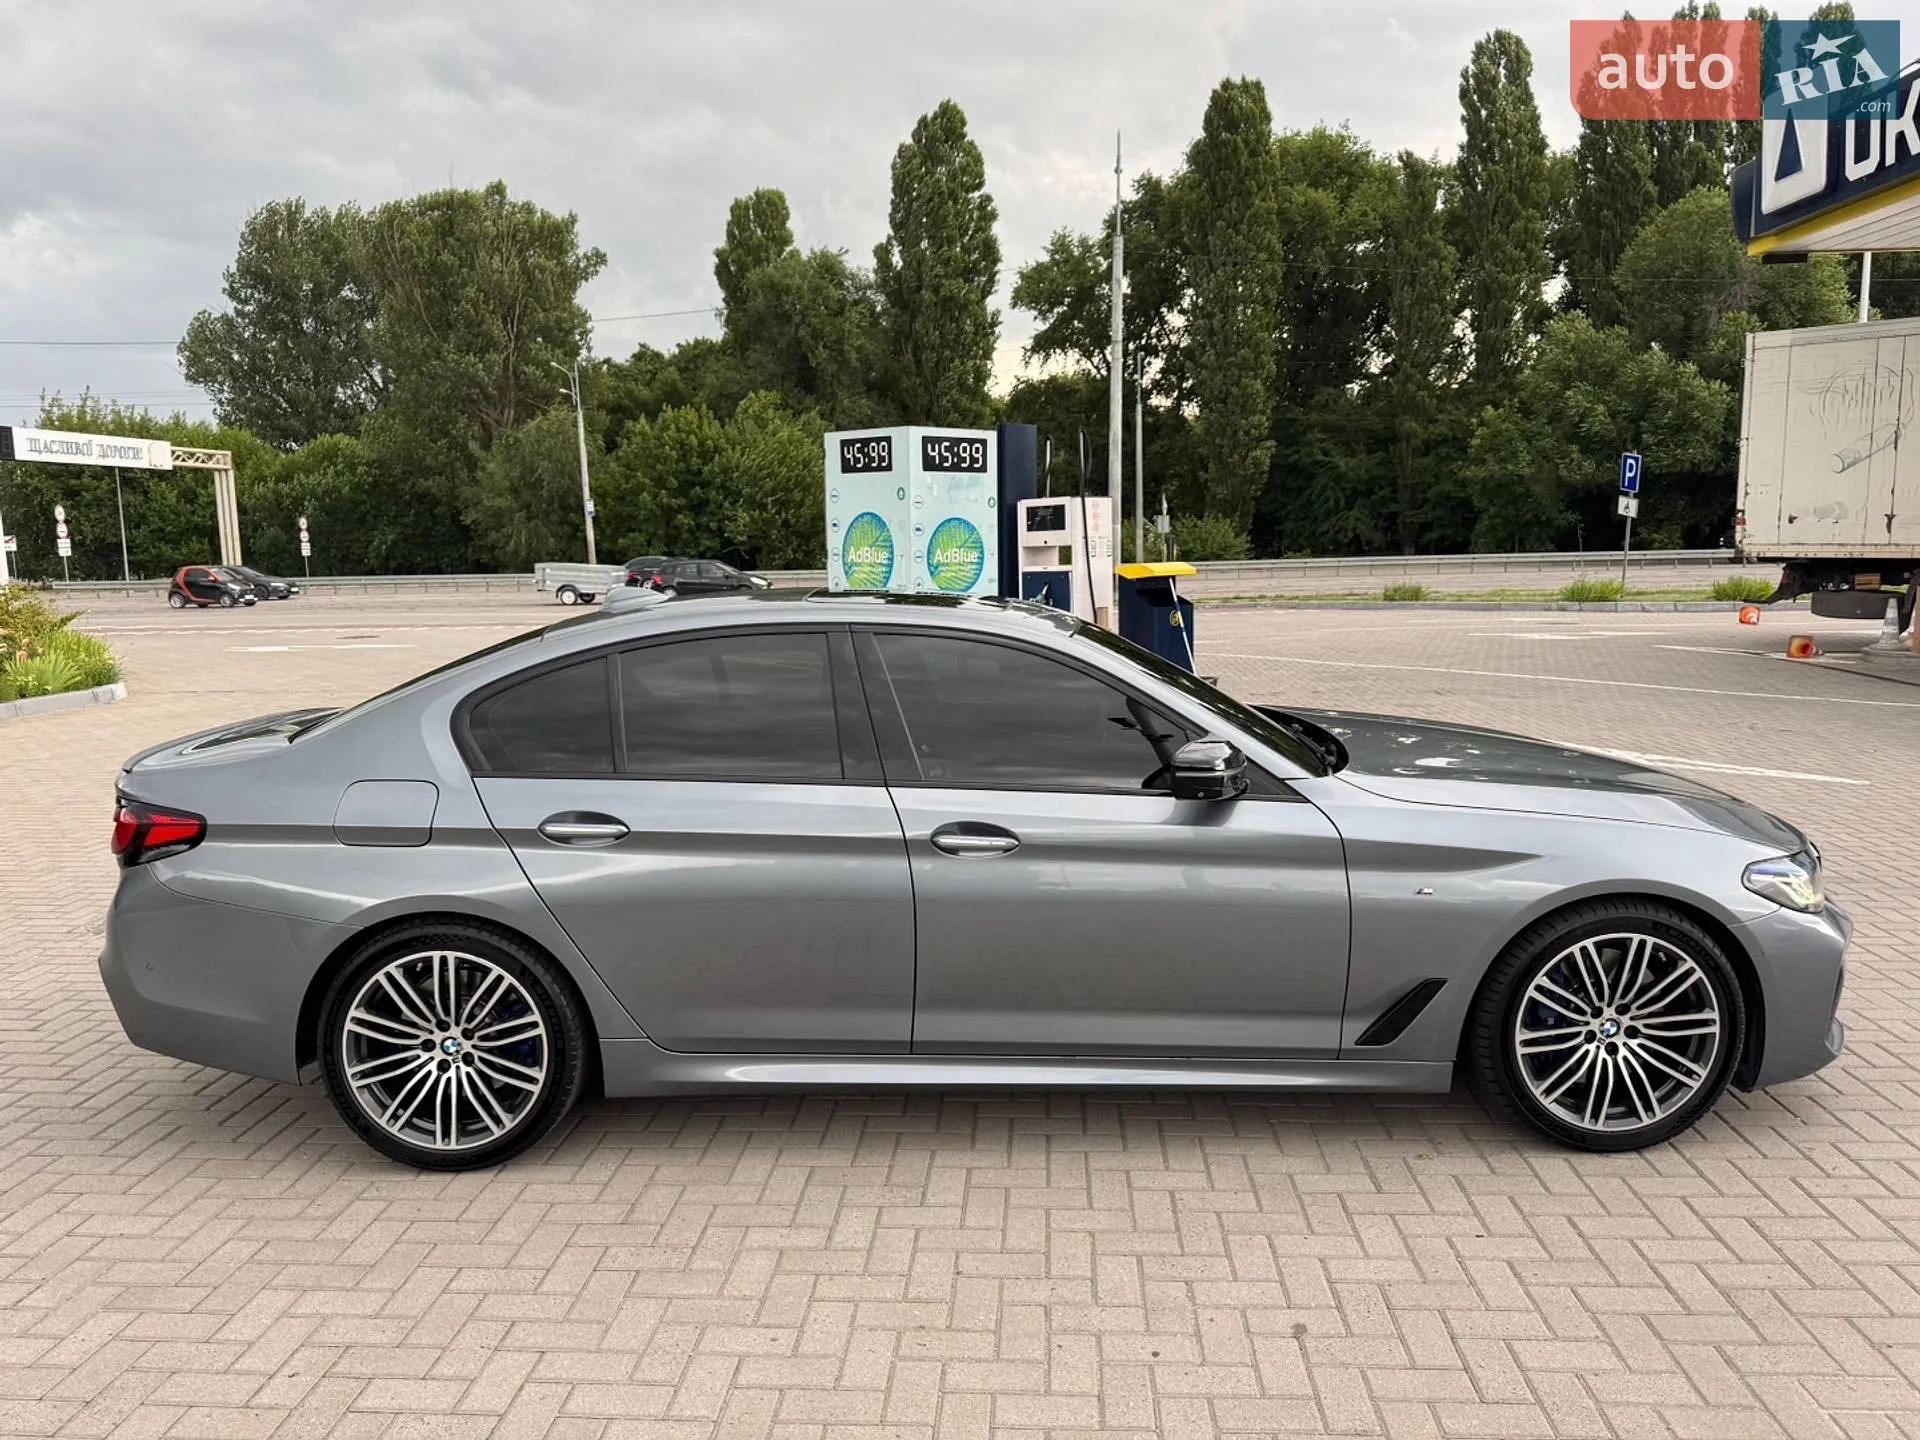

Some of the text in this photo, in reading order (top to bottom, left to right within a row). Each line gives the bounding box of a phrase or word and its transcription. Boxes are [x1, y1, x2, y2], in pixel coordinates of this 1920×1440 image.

[844, 441, 888, 468] 45:99
[927, 442, 983, 468] 45:99
[1624, 458, 1636, 487] P
[848, 546, 888, 564] AdBlue
[933, 548, 979, 564] AdBlue
